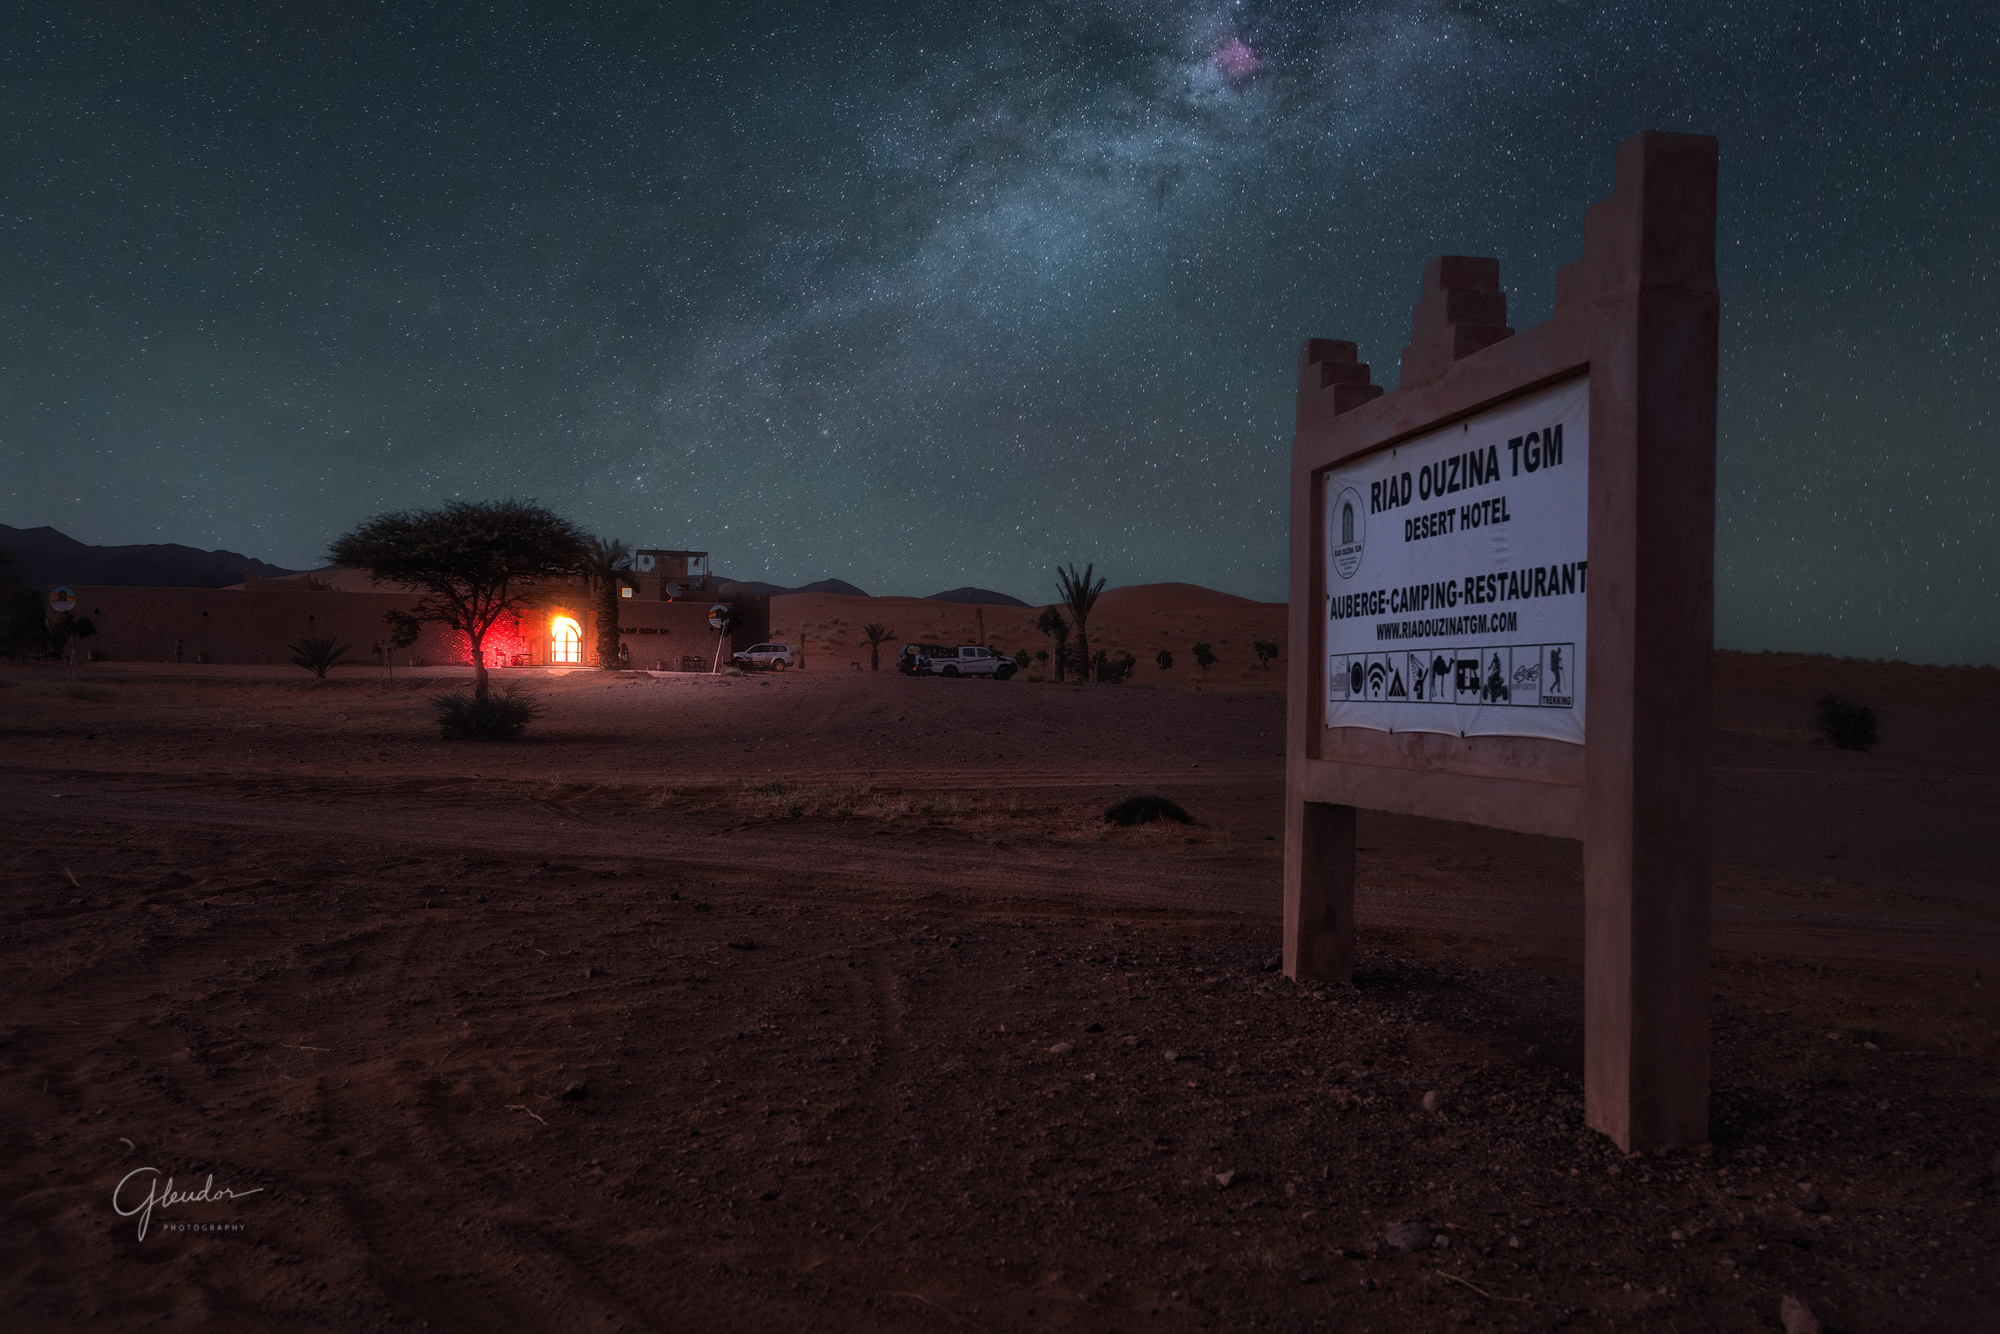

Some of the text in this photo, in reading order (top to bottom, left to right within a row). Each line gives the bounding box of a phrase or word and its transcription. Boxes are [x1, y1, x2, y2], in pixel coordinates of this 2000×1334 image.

[1370, 423, 1563, 515] RIAD OUZINA TGM
[1405, 496, 1510, 542] DESERT HOTEL
[1330, 561, 1588, 620] AUBERGE-CAMPING-RESTAURANT
[1376, 611, 1518, 641] WWW.RIADOUZINATGM.COM
[1542, 695, 1571, 705] TREKKING
